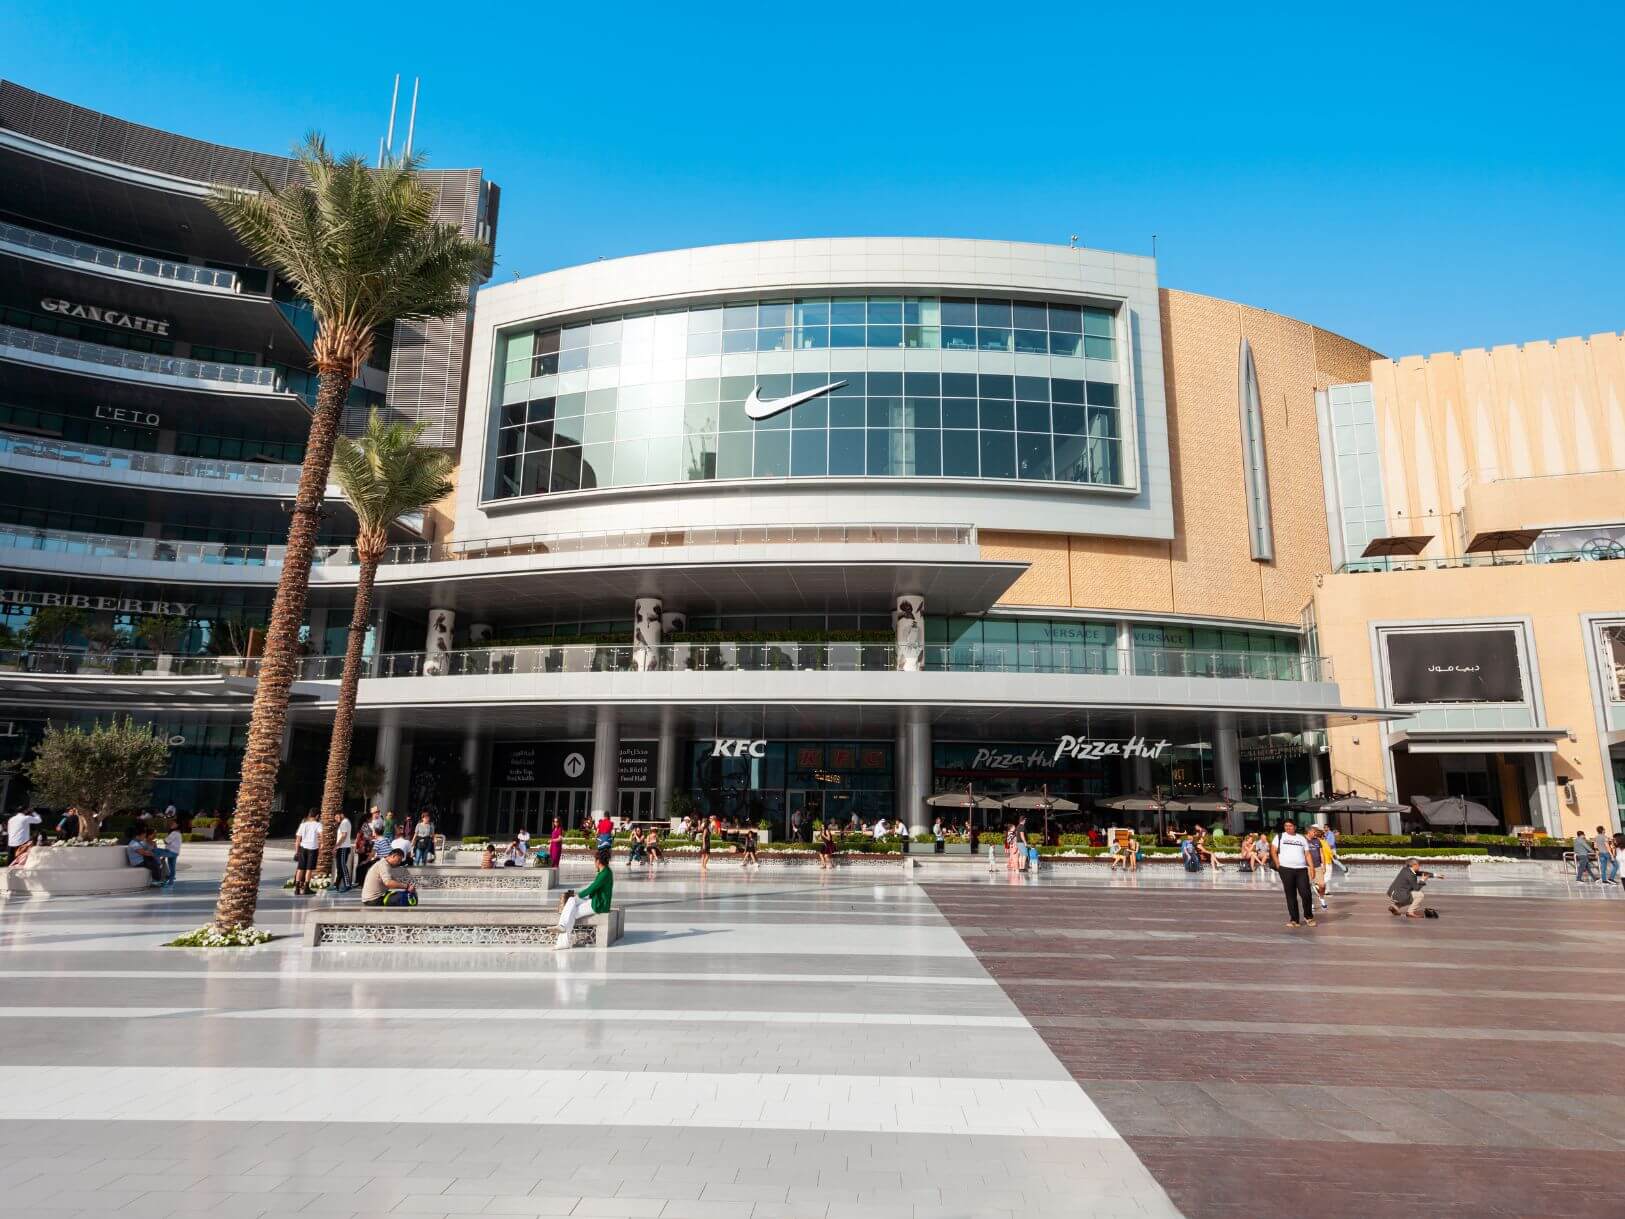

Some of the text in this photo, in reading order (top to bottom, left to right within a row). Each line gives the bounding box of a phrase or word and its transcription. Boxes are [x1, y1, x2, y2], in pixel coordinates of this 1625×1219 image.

[1043, 627, 1099, 640] VERSACE
[710, 739, 768, 758] KFC
[1053, 735, 1173, 761] Pizza Hut
[971, 748, 1024, 769] Pizza
